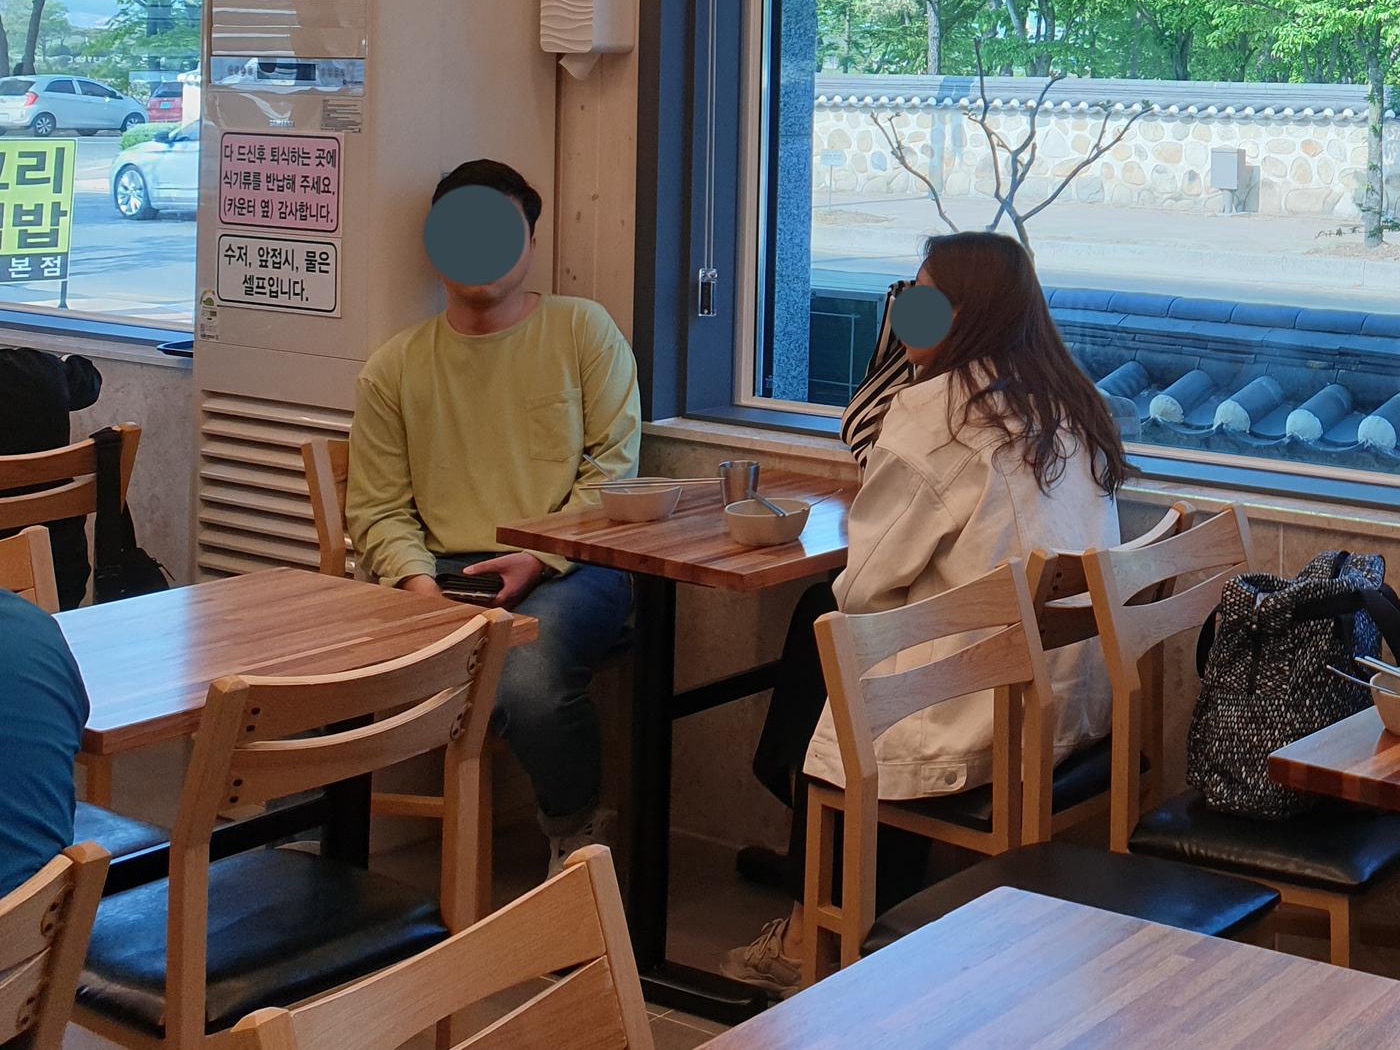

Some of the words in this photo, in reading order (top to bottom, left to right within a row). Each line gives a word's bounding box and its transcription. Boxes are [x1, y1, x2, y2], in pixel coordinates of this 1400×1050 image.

[223, 144, 234, 162] 다
[237, 145, 266, 164] 드신후
[270, 146, 311, 166] 퇴식하는
[315, 148, 336, 168] 곳에
[0, 147, 65, 194] 리
[223, 170, 262, 191] 식기류를
[266, 172, 296, 193] 반납해
[300, 175, 335, 196] 주세요.
[224, 196, 256, 217] (카운터
[260, 198, 274, 219] 옆)
[278, 201, 333, 223] 감사합니다.
[0, 202, 67, 249] 밥
[223, 243, 252, 268] 수저,
[257, 246, 299, 272] 앞접시,
[304, 250, 331, 274] 물은
[242, 274, 309, 302] 셀프입니다.
